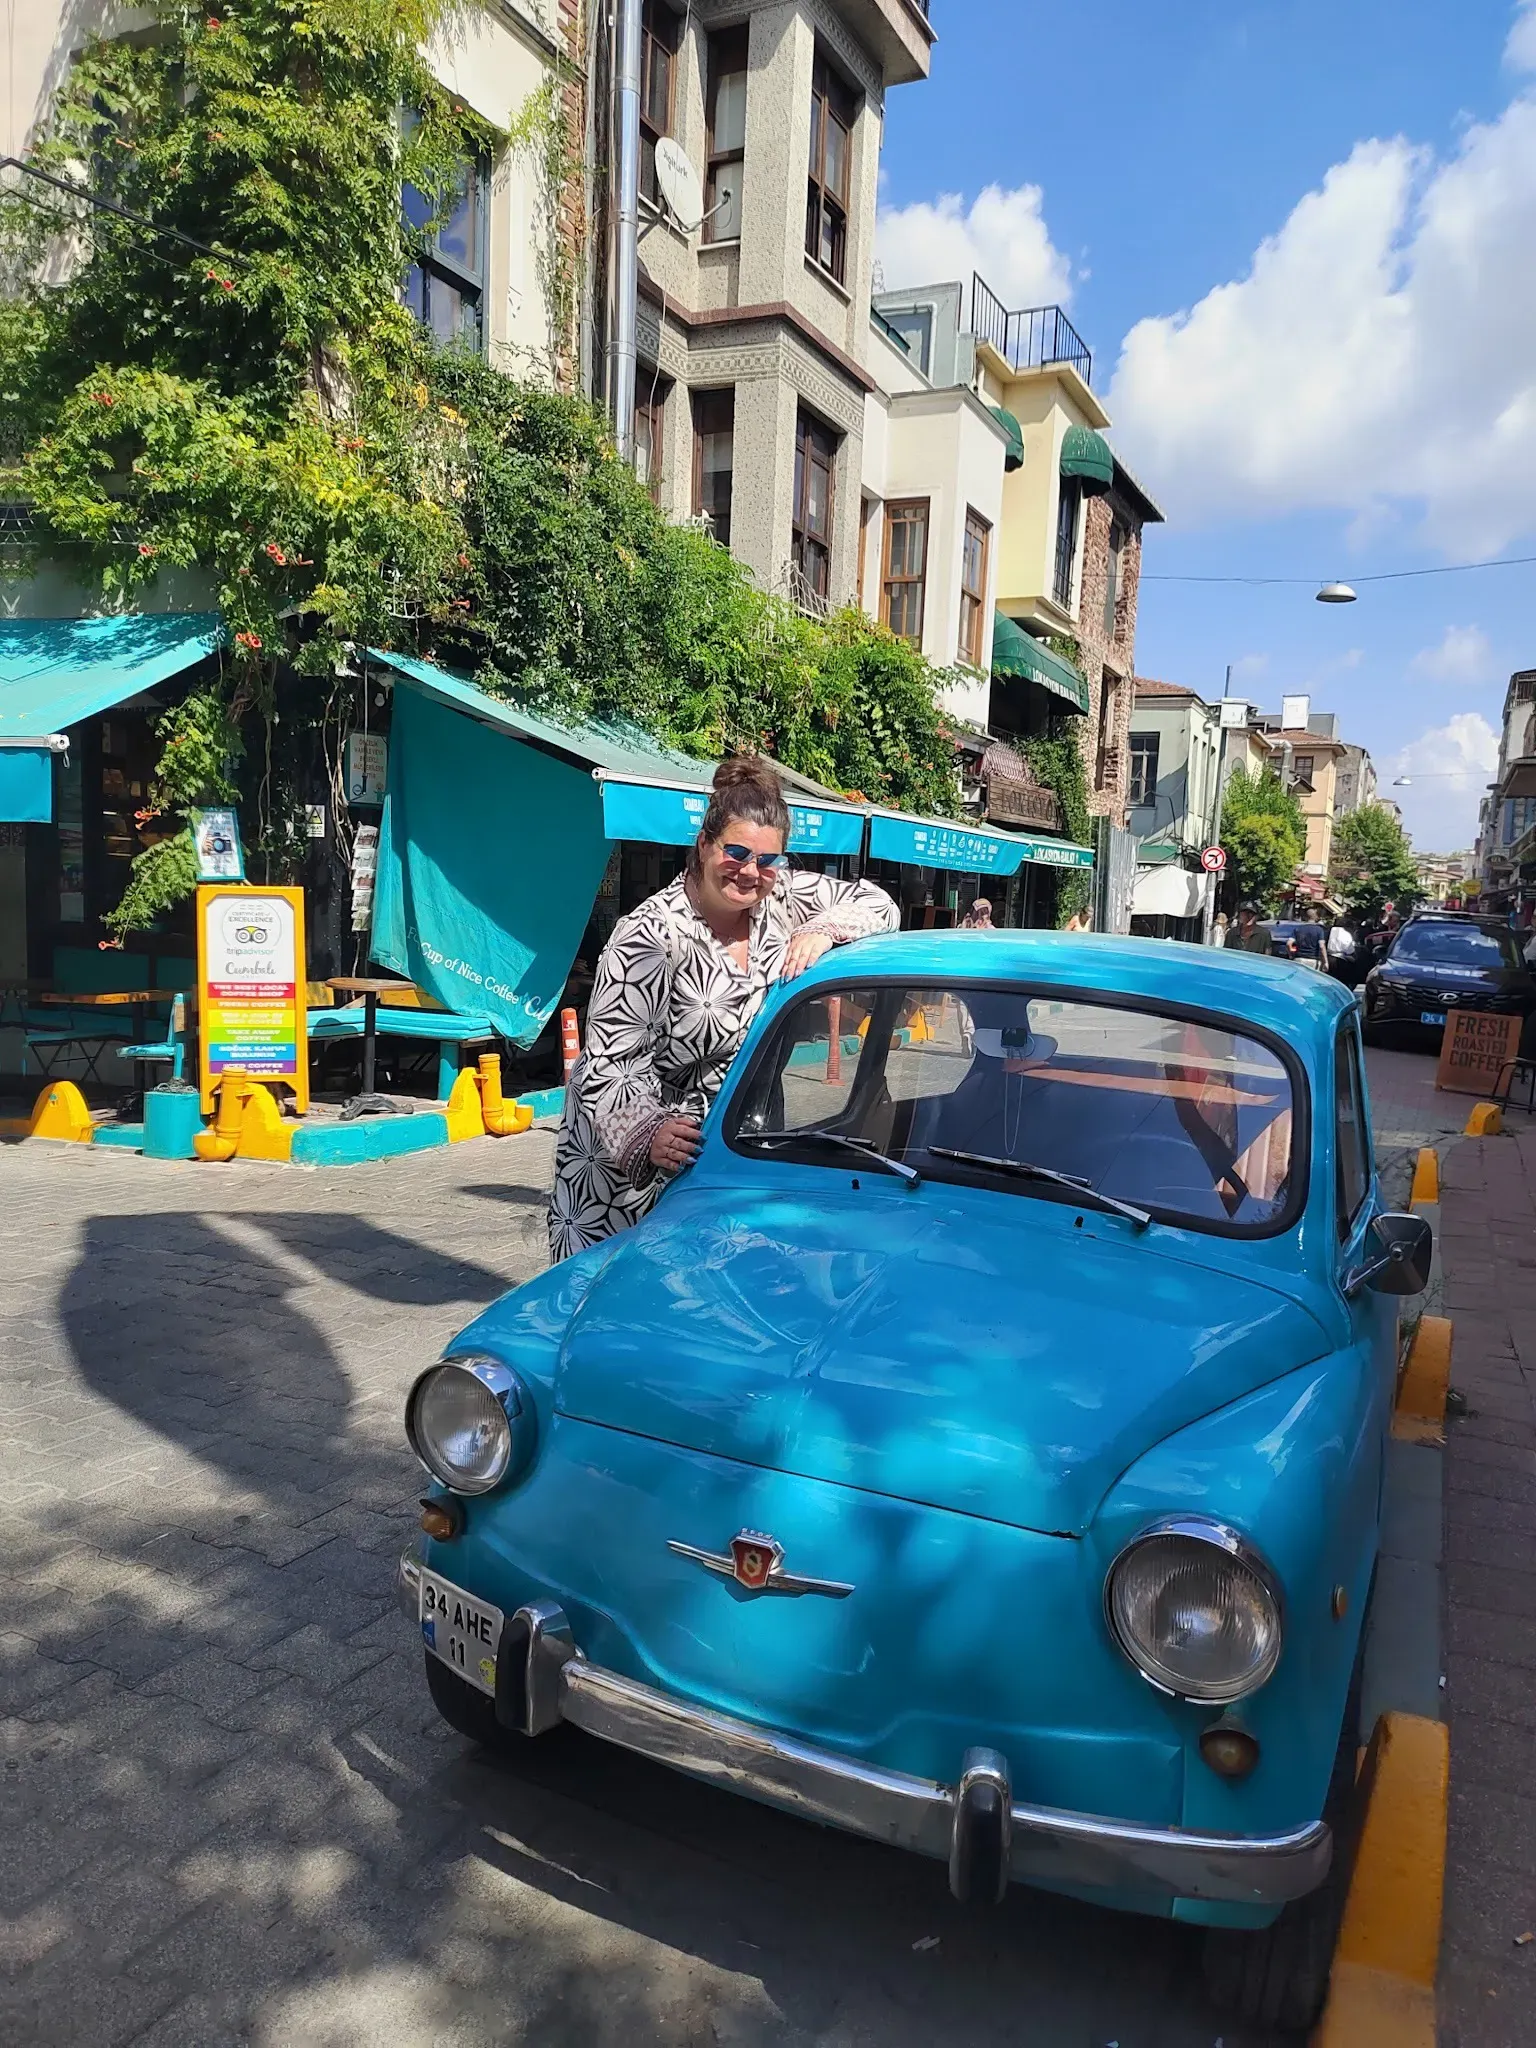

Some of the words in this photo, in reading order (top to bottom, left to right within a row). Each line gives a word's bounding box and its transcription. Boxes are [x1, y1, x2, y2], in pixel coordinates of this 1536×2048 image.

[226, 946, 275, 956] tripadvisor
[421, 942, 443, 965] Cup
[445, 958, 458, 973] of
[457, 960, 483, 985] Nice
[484, 976, 520, 1004] Coffee
[1456, 1015, 1511, 1039] FRESH
[1452, 1036, 1508, 1056] ROASTED
[1449, 1051, 1506, 1073] COFFEE
[425, 1585, 448, 1618] 34
[454, 1602, 493, 1647] AHE
[449, 1636, 465, 1667] 11
